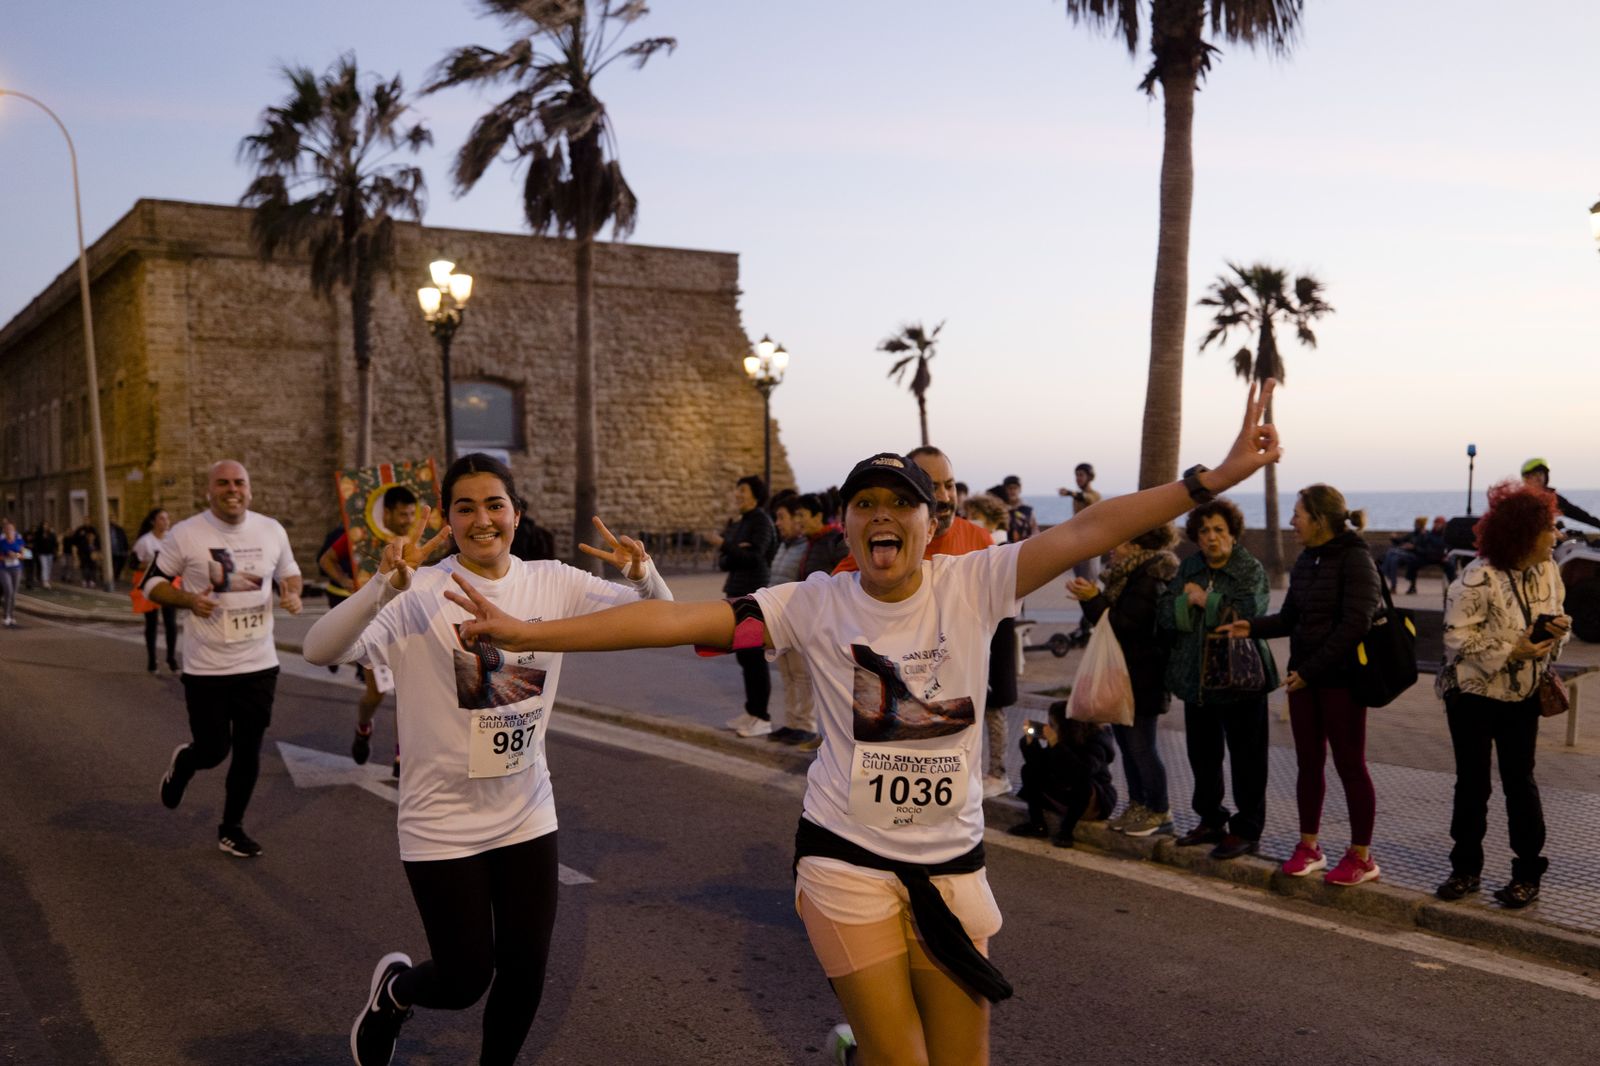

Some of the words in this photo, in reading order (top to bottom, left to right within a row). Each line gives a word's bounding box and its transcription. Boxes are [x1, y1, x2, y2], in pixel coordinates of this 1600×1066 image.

[232, 614, 264, 630] 1121
[479, 720, 516, 729] CIUDAD
[517, 719, 528, 727] DE
[493, 724, 536, 755] 987
[863, 751, 891, 761] SAN
[894, 755, 961, 765] SILVESTRE
[862, 760, 909, 772] CIUDAD
[911, 763, 927, 774] DE
[869, 774, 953, 807] 1036
